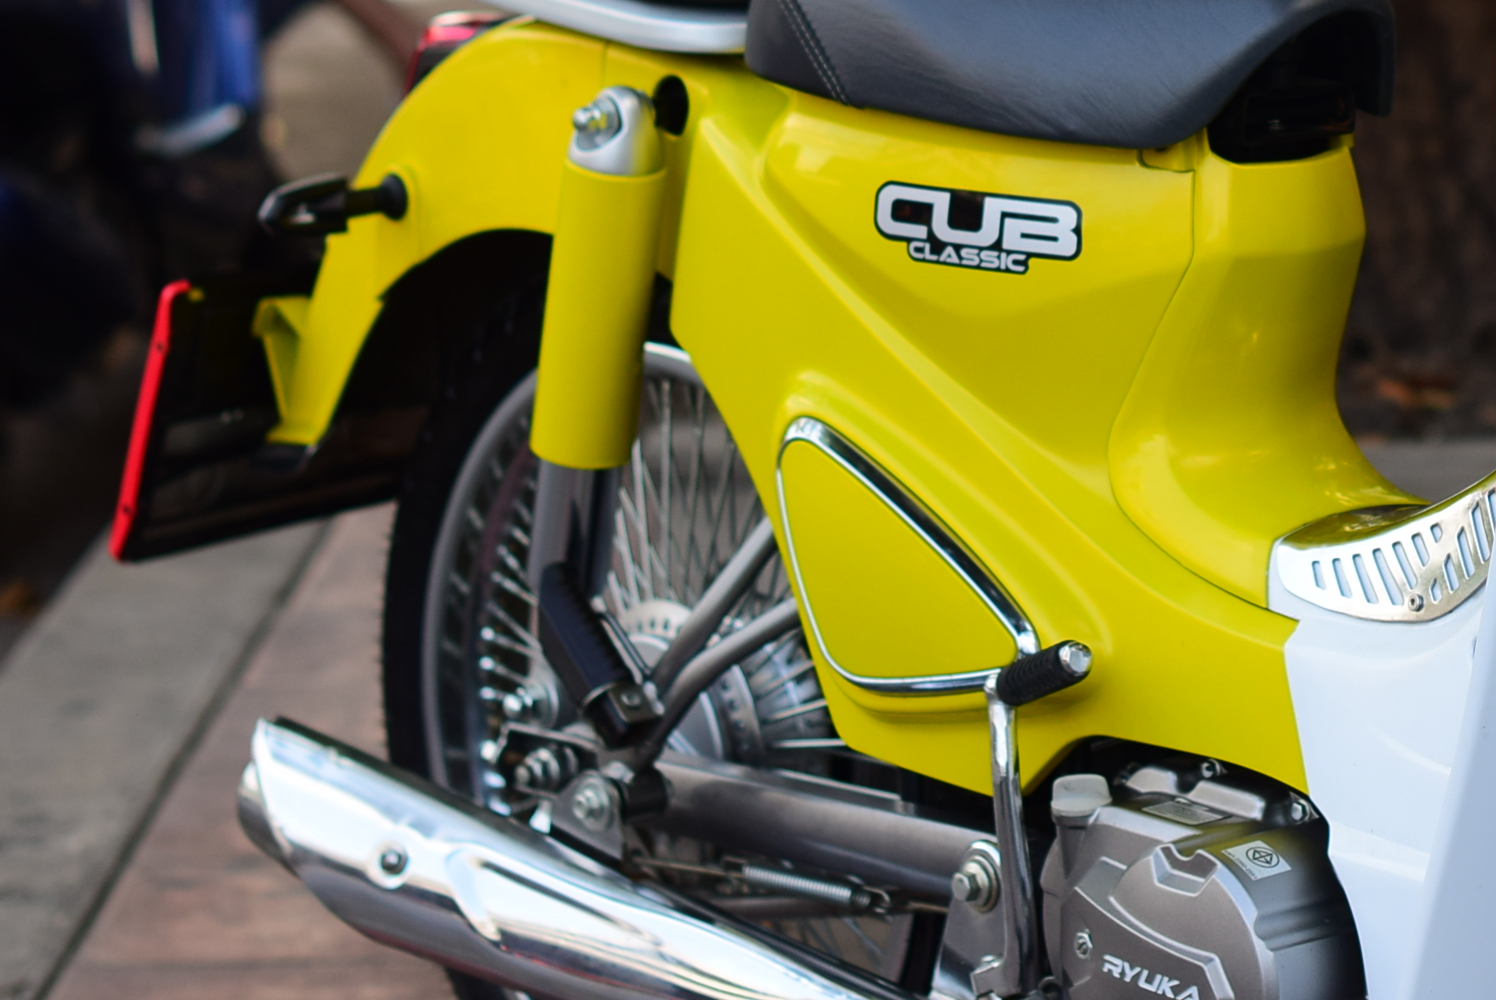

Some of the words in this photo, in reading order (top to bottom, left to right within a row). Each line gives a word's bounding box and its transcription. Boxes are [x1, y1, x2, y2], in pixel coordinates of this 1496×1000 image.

[877, 184, 1078, 257] CUB
[909, 241, 1026, 272] CLASSIC
[1102, 954, 1200, 1000] RYUKA
